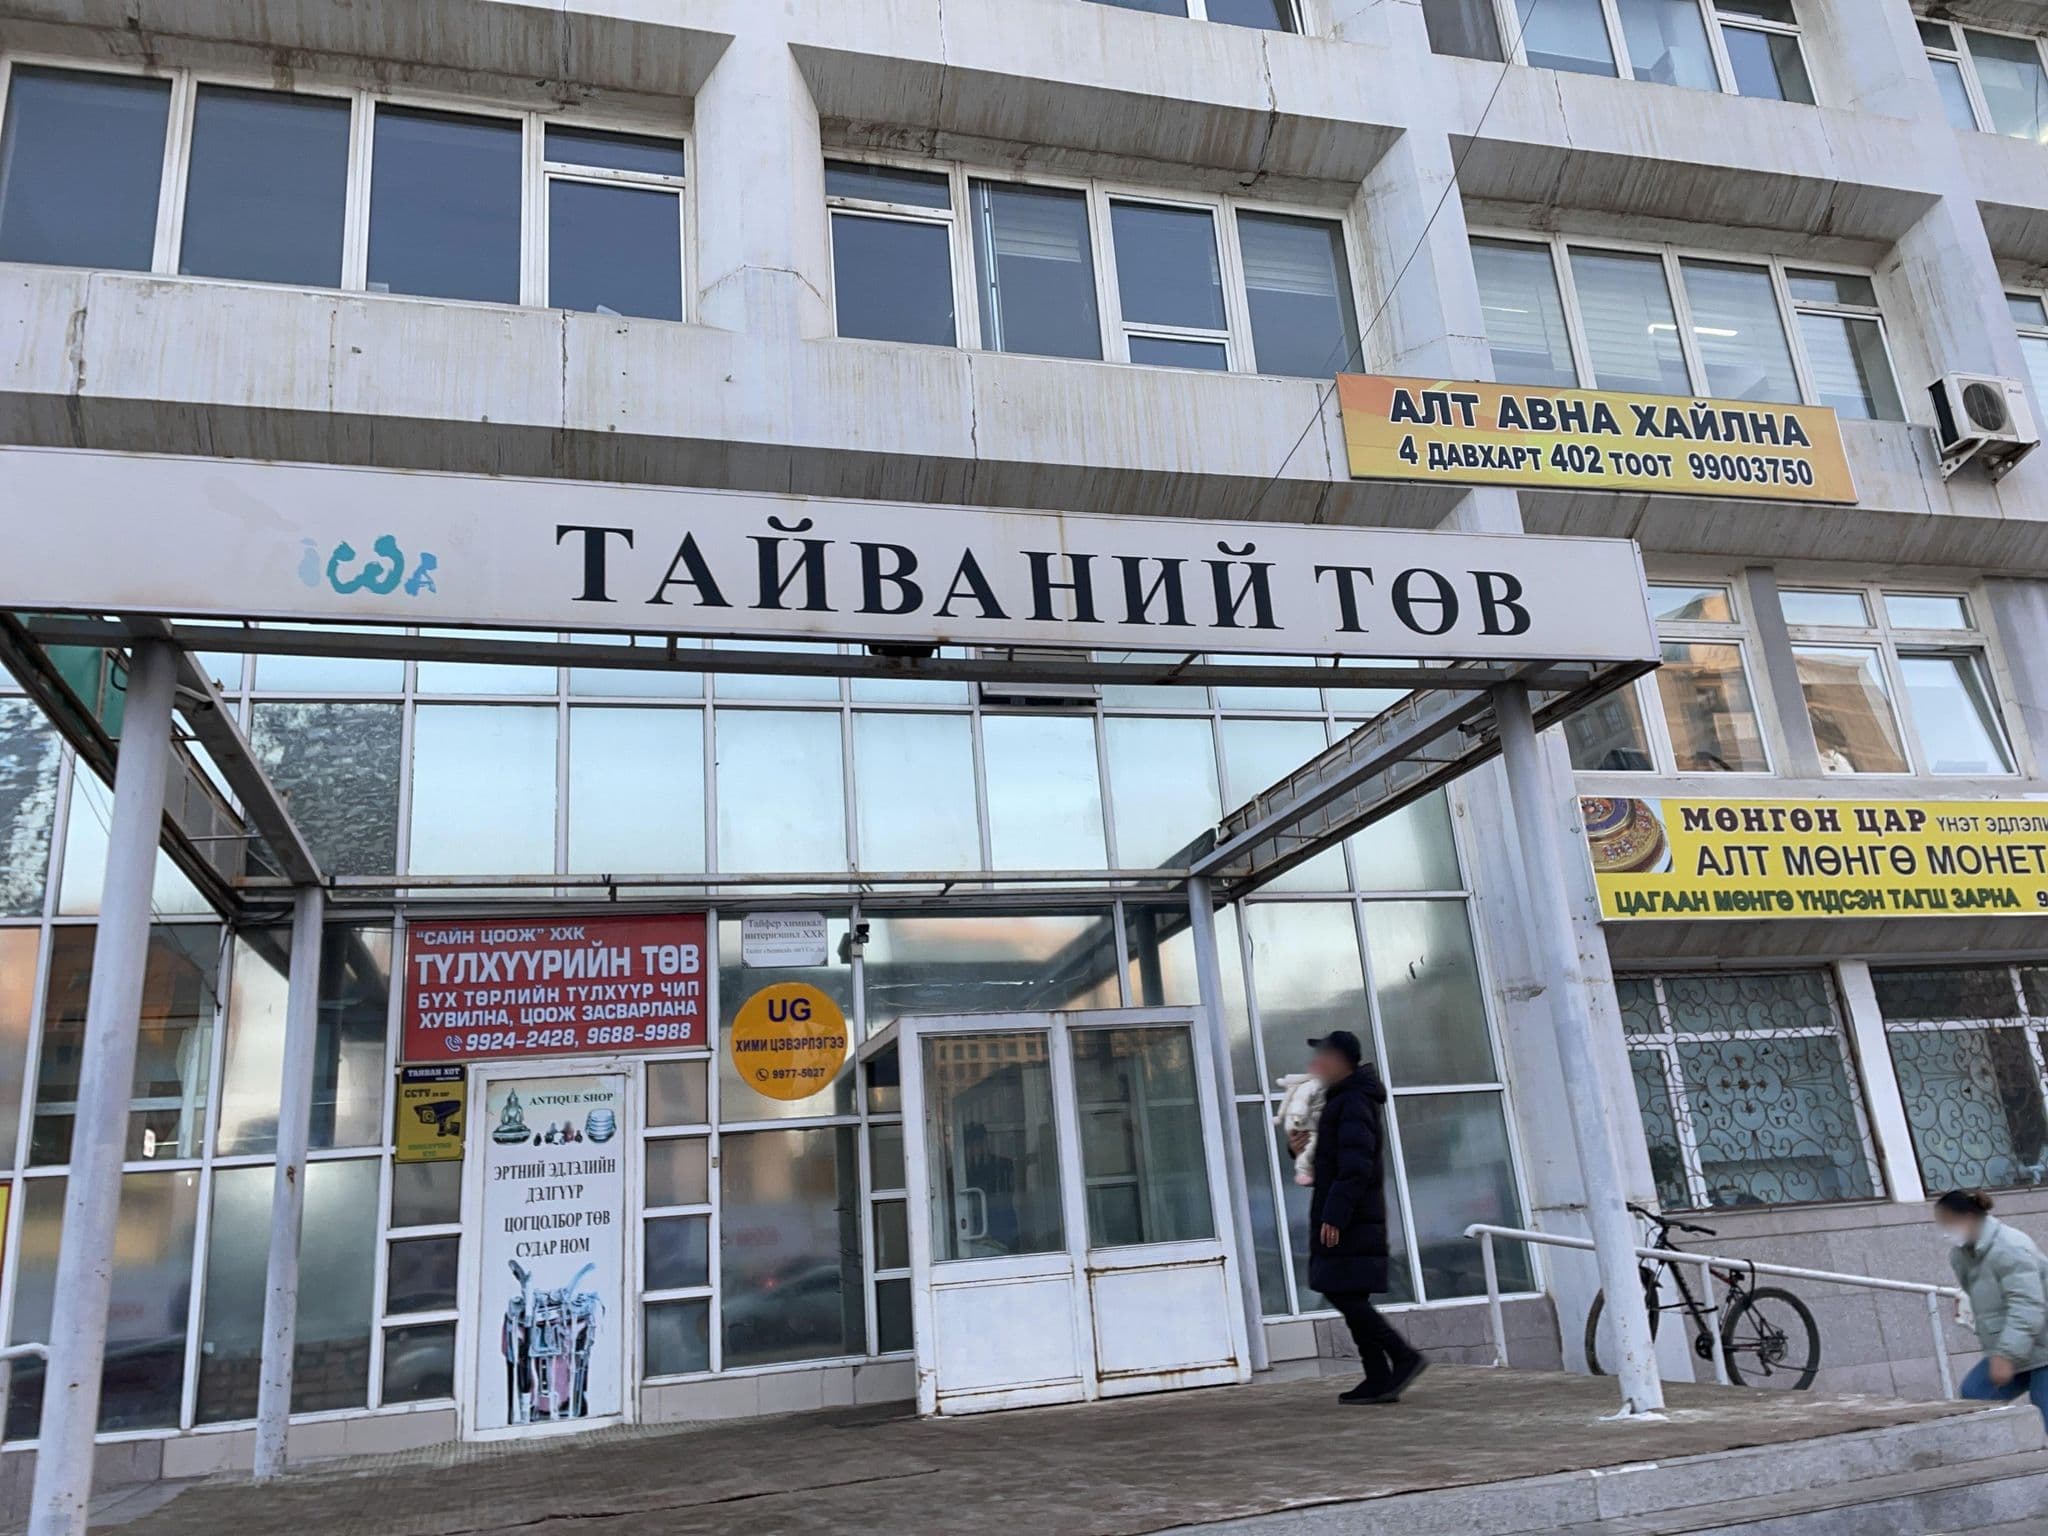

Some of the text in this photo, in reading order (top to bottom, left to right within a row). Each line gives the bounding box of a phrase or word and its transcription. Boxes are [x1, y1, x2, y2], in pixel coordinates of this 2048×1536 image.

[1390, 389, 1811, 448] АЛТ АВНА ХАЙЛНА
[1399, 436, 1814, 486] 4 ДАВХАРТ 402 ТООТ 99003750
[557, 515, 1532, 637] ТАЙВАНИЙ ТӨВ
[1681, 808, 1843, 833] МӨНГӨН
[1854, 809, 1926, 837] ЦАР
[1936, 816, 1979, 832] ҮНЭТ
[1697, 844, 2047, 877] АЛТ МӨНГӨ МОНЕТ
[1614, 890, 1710, 916] ЦАГААН
[1713, 890, 1795, 912] МӨНГӨ
[1797, 888, 1885, 914] ҮНДСЭН
[1951, 887, 2021, 908] ЗАРНА
[550, 926, 585, 941] ХХК
[802, 929, 825, 939] ХХК
[415, 940, 700, 985] ТҮЛХҮҮРИЙН ТӨВ
[418, 981, 699, 1009] БҮХ ТӨРЛИЙН ТҮЛХҮҮР ЧИП
[419, 1000, 698, 1029] ХУВИЛНА, ЦООЖ ЗАСВАРЛАНА
[768, 998, 812, 1023] UG
[465, 1022, 692, 1051] 9924-2428, 9688-9988
[736, 1039, 768, 1053] ХИМИ
[404, 1088, 431, 1098] CCTV
[529, 1092, 614, 1106] ANTIQUE SHOP
[494, 1156, 616, 1181] ЭРТНИЙ ЭДЛЭЛИЙН
[525, 1184, 584, 1204] ДЭЛГҮҮР
[504, 1210, 611, 1233] ЦОГЦОЛБОР ТӨВ
[516, 1237, 590, 1258] СУДАР НОМ
